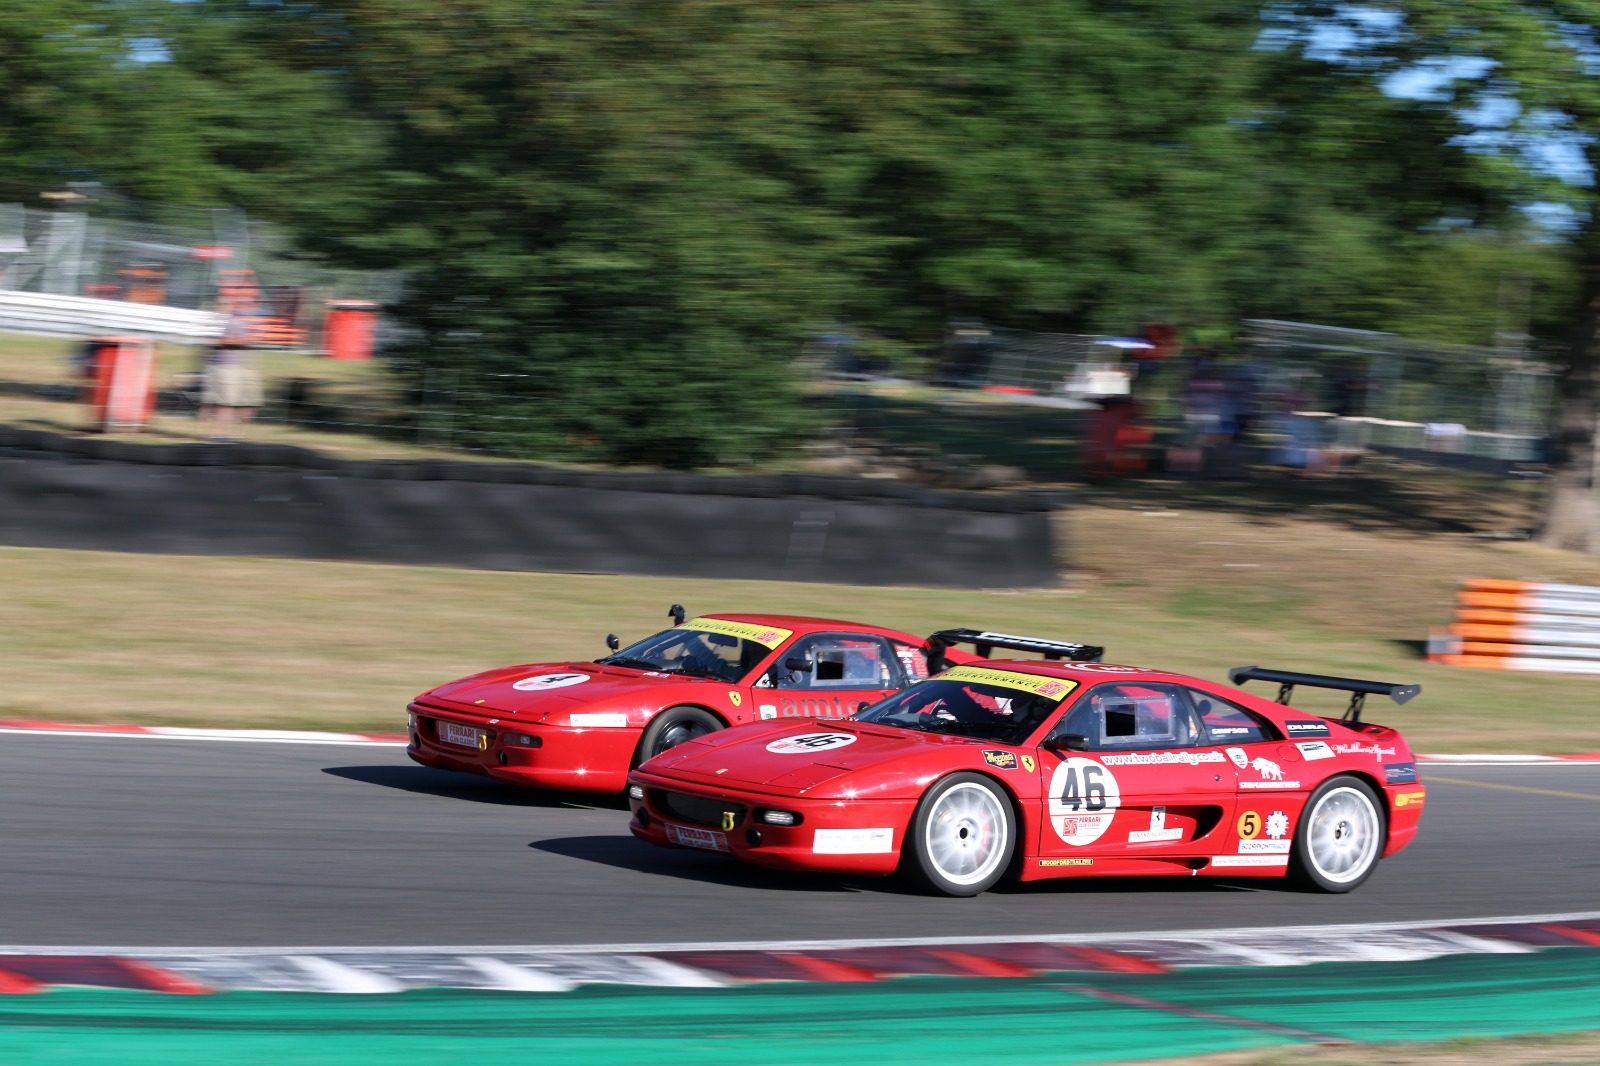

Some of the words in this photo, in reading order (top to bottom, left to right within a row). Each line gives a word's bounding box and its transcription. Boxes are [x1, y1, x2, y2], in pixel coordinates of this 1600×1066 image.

[449, 724, 475, 739] FERRARI
[1211, 727, 1249, 735] SIMPSON
[793, 734, 851, 747] 46
[1061, 765, 1106, 812] 46
[1243, 815, 1255, 836] 5
